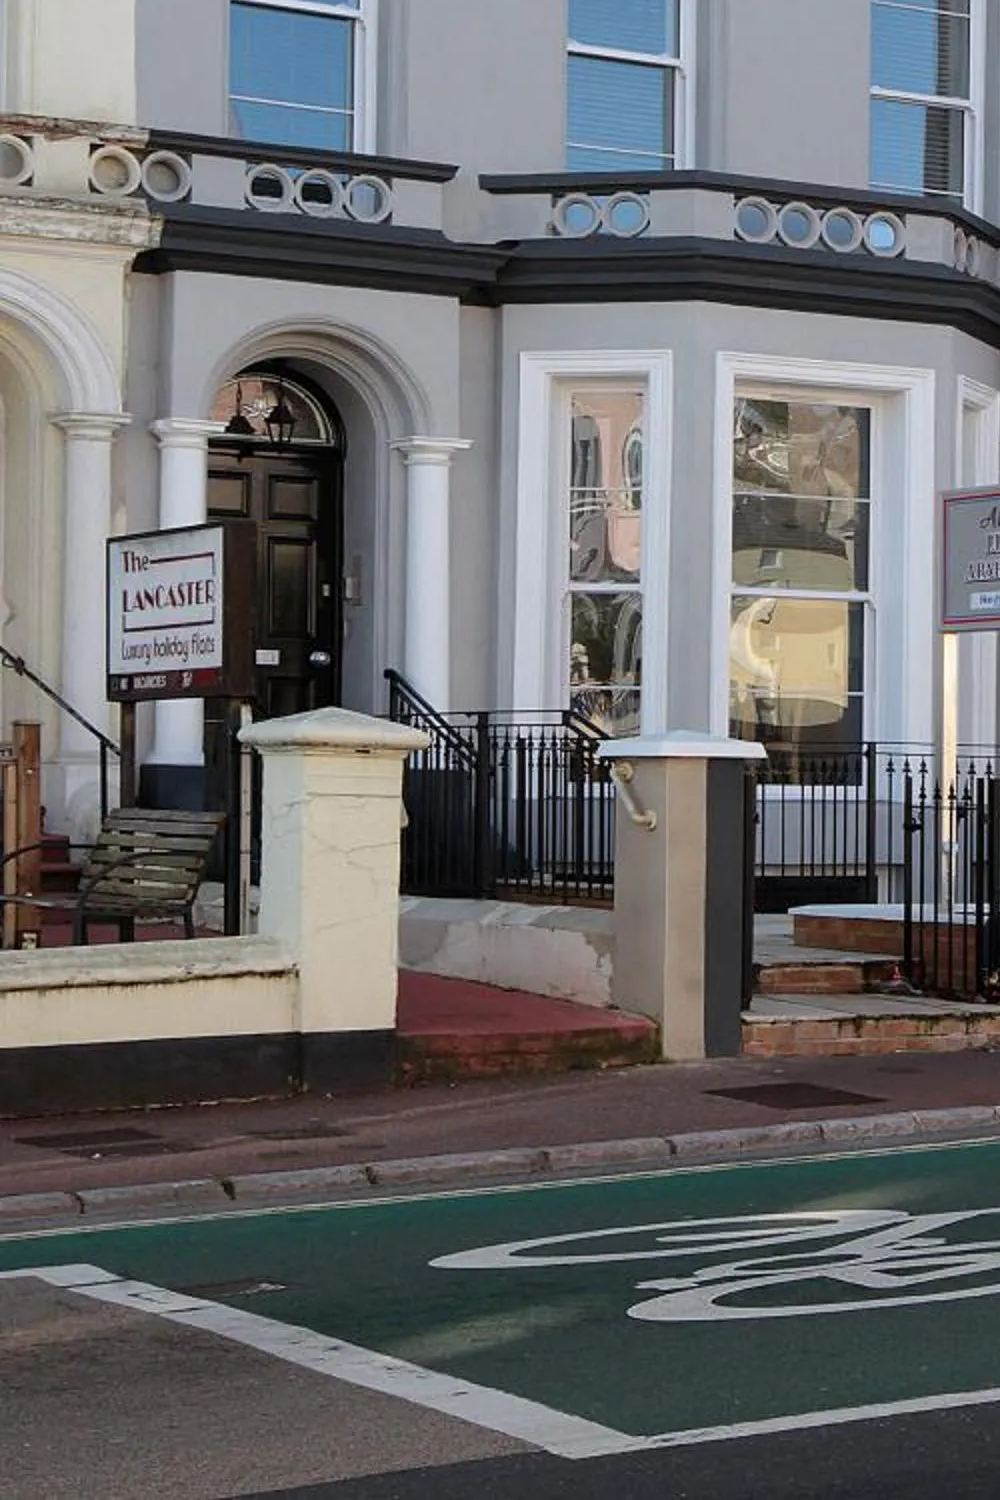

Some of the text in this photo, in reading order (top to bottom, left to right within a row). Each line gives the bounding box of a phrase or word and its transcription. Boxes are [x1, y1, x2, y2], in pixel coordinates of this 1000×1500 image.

[122, 551, 151, 573] The
[122, 579, 215, 612] LANCASTER
[122, 640, 151, 665] Luxury
[153, 635, 189, 662] holiday
